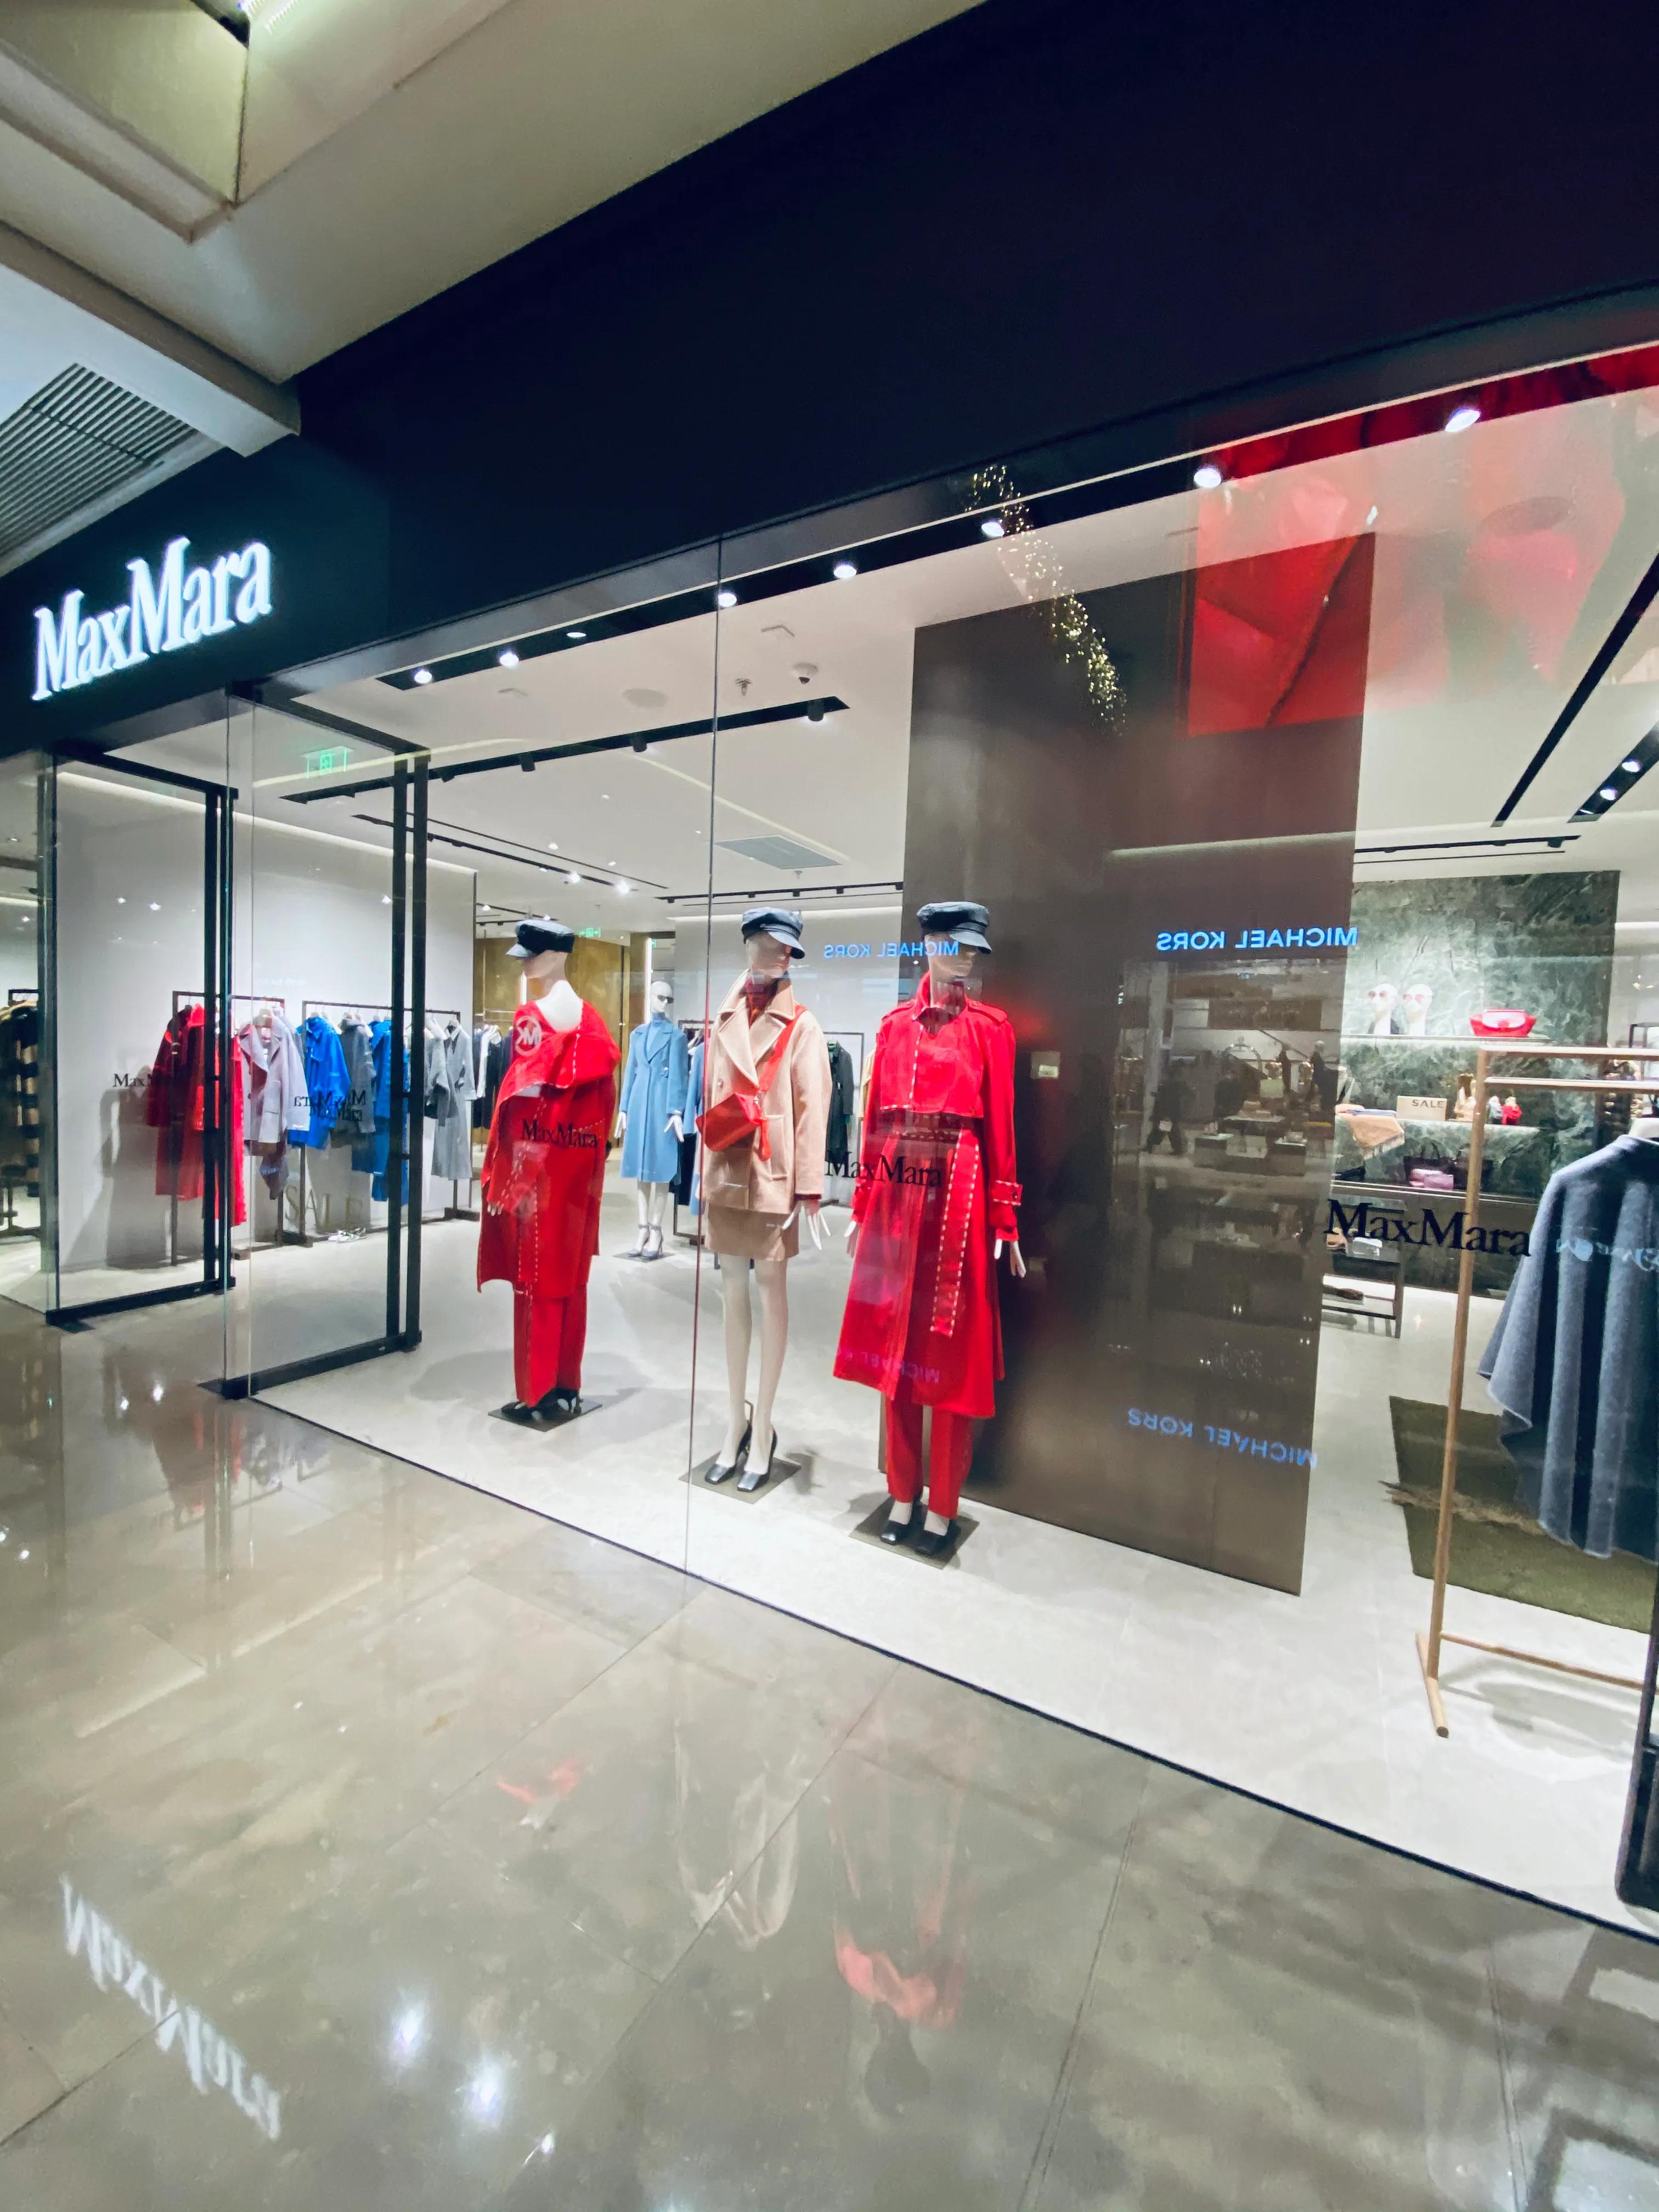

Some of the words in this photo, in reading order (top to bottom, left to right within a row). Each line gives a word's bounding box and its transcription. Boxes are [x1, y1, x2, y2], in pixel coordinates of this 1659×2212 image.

[31, 535, 273, 701] MaxMara
[1412, 1099, 1444, 1108] SALE
[522, 1119, 599, 1148] MaxMara
[824, 1150, 943, 1187] MaxMara
[1323, 1199, 1531, 1257] MaxMara
[1128, 1408, 1193, 1438] KORS
[1204, 1425, 1318, 1469] MICHAEL
